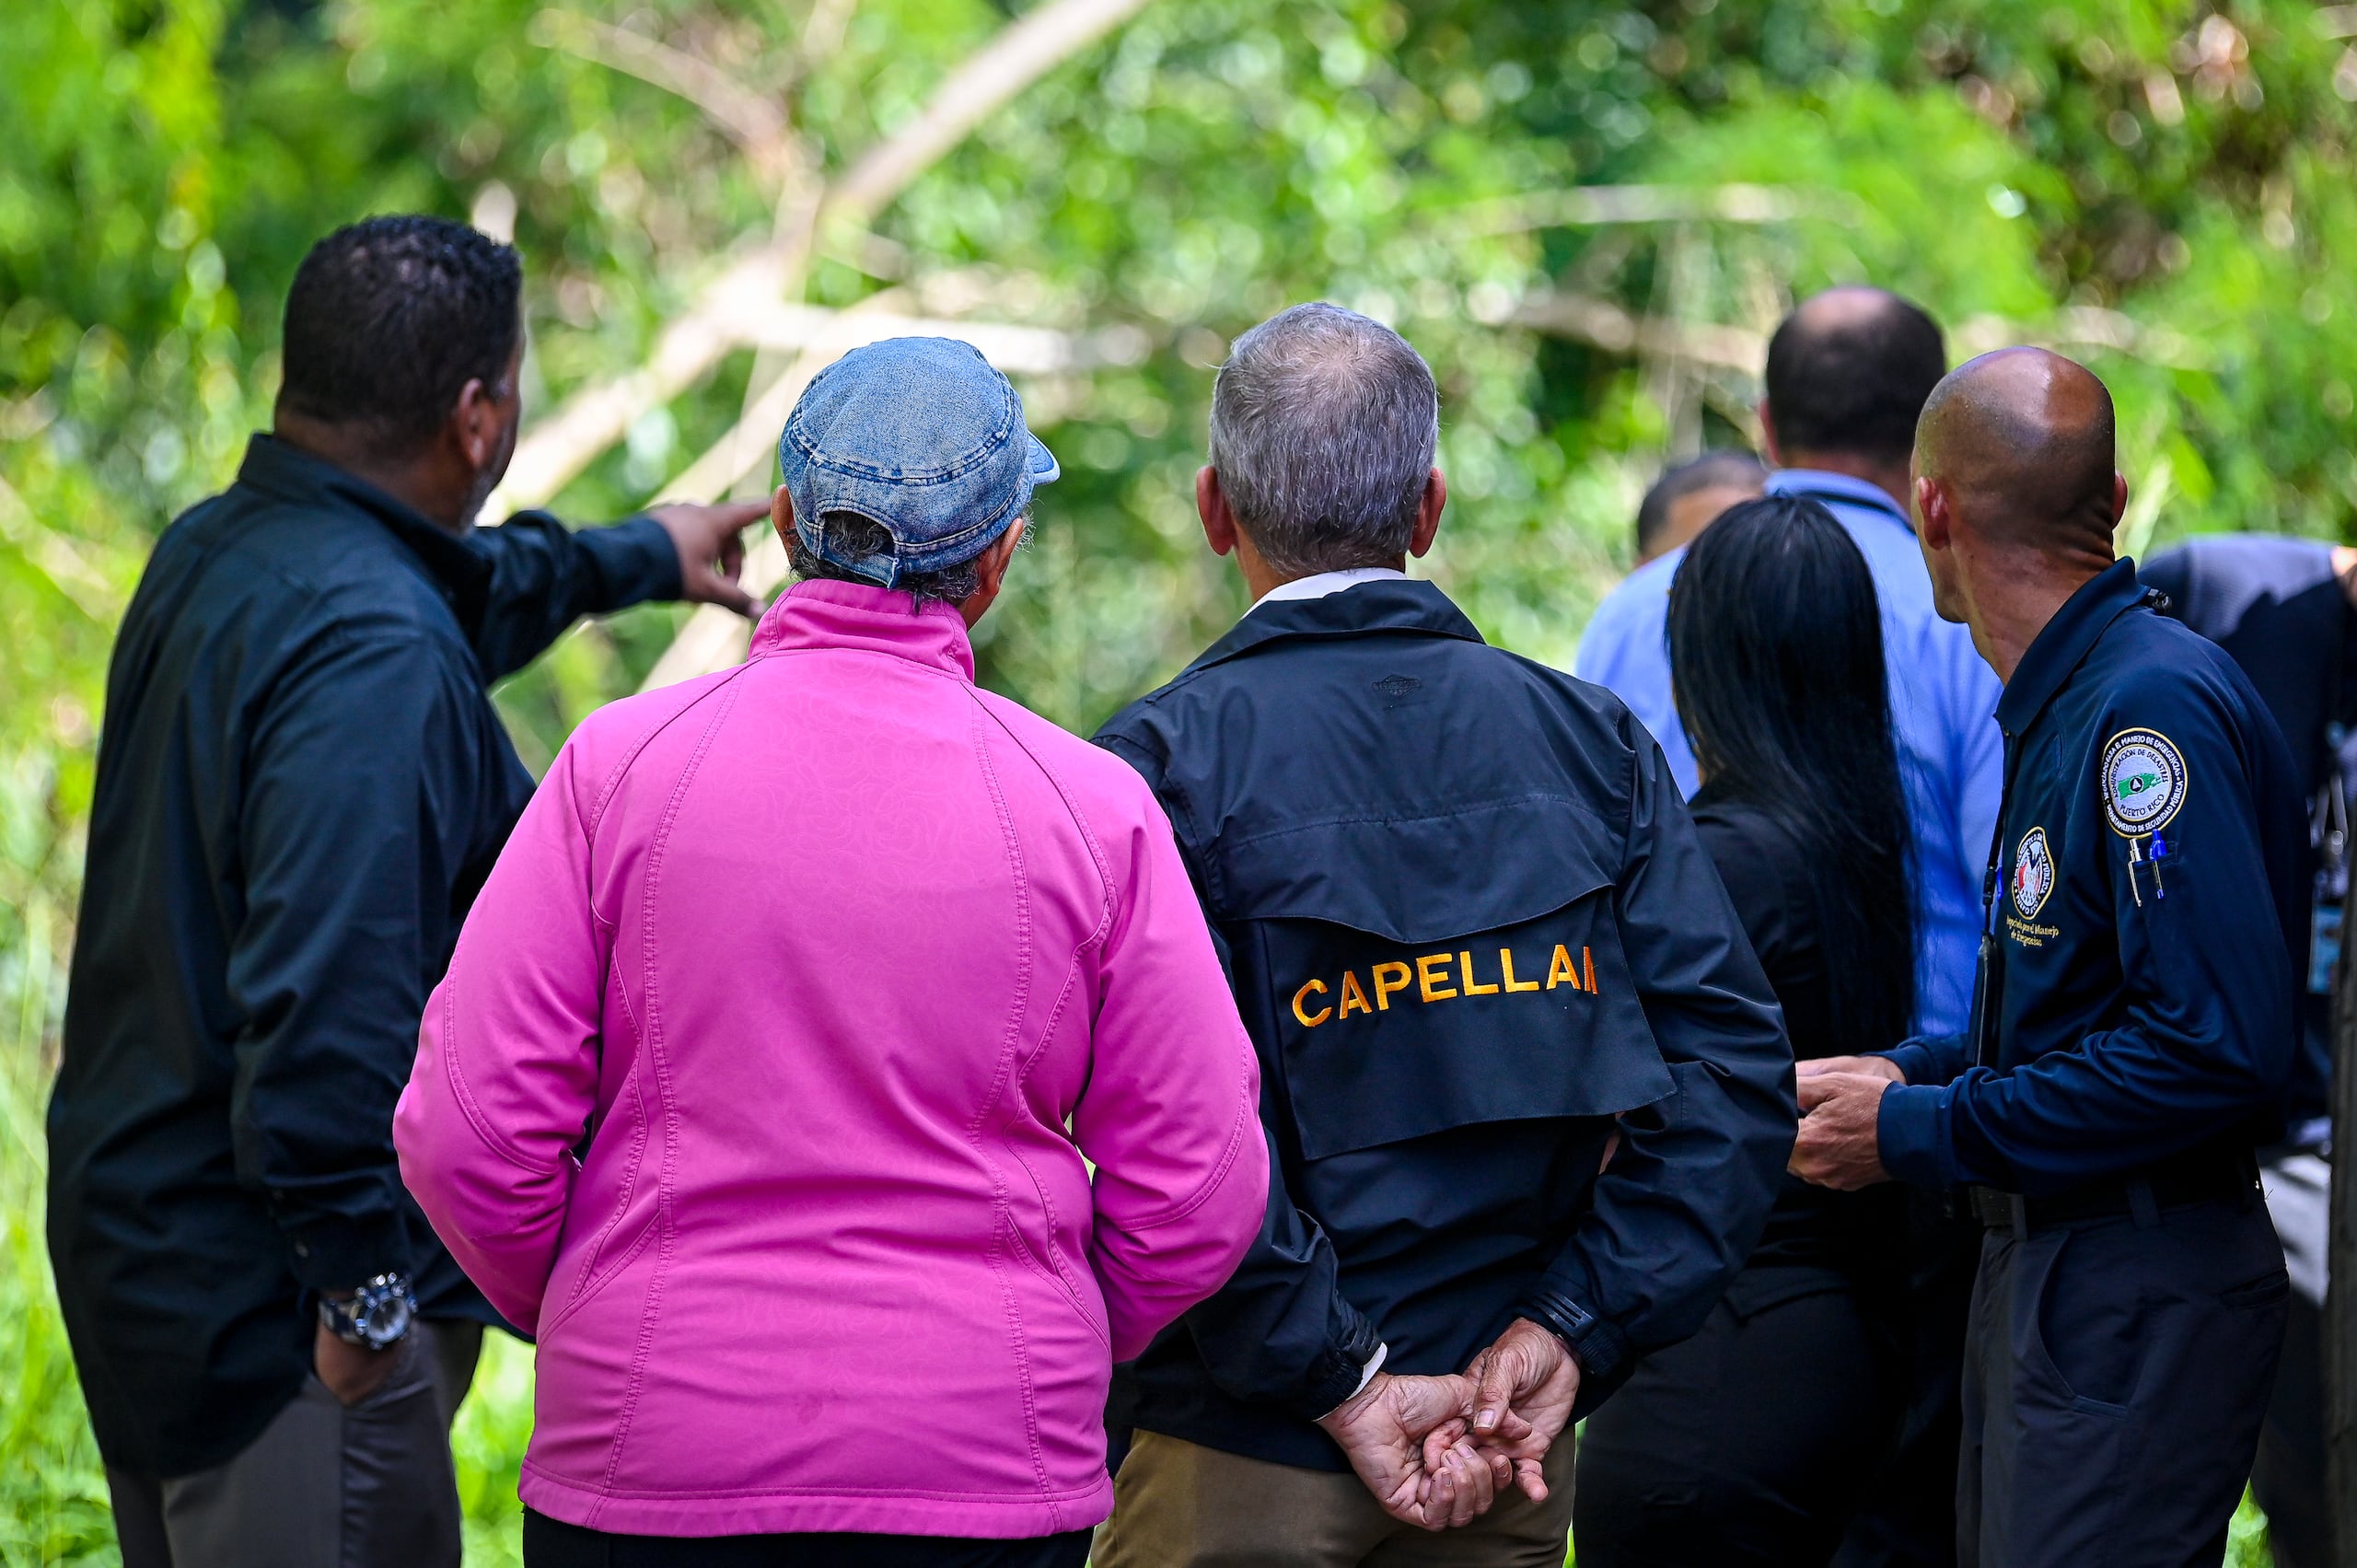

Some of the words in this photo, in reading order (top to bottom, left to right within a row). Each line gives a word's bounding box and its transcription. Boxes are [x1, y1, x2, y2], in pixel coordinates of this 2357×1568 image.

[2121, 735, 2145, 746] MANEJO
[2146, 736, 2154, 744] DE
[2154, 739, 2182, 778] EMERGENCIAS
[2146, 751, 2169, 783] DESASTRES
[2119, 804, 2146, 817] PUERTO
[2147, 794, 2165, 812] RICO
[2138, 824, 2145, 832] DE
[2145, 806, 2174, 829] SEGURIDAD
